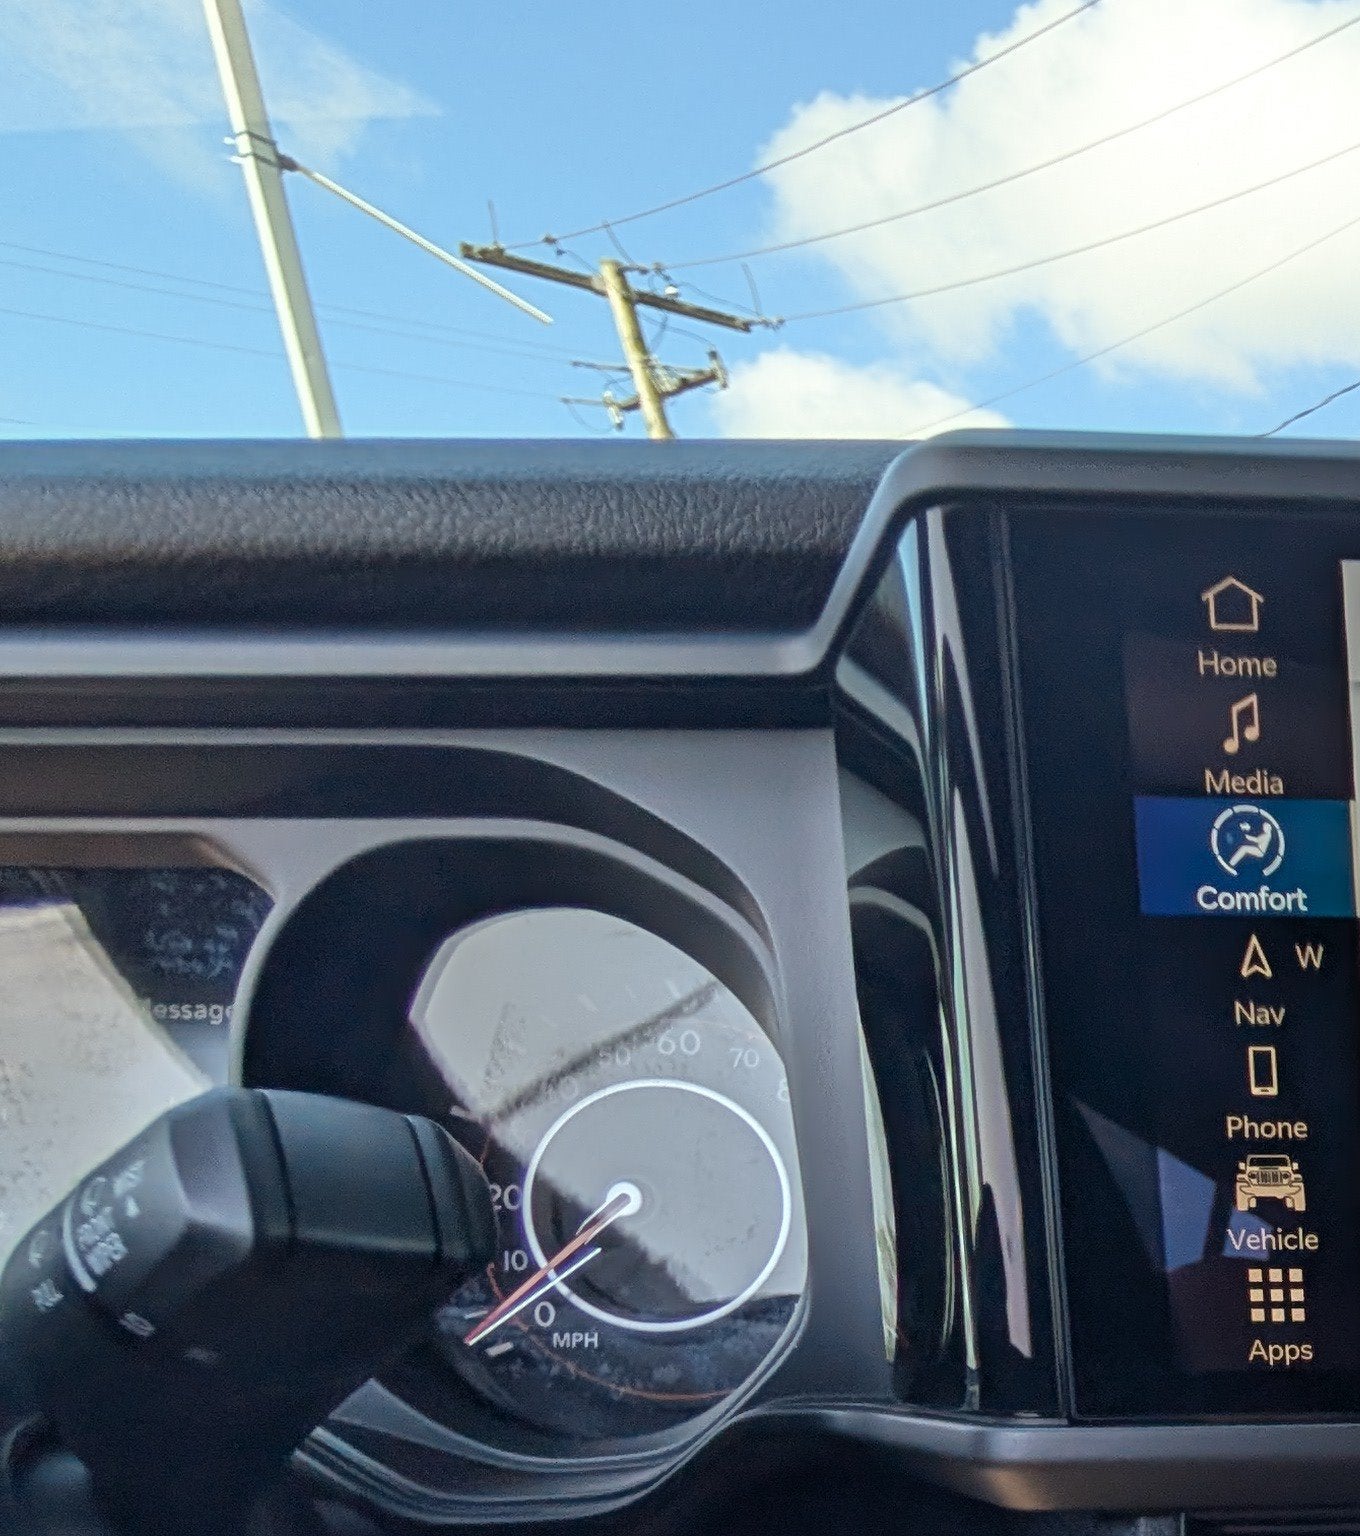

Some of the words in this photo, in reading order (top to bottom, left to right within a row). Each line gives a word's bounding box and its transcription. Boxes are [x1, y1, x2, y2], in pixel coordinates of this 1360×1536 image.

[1198, 650, 1278, 679] Home
[1204, 769, 1285, 796] Media
[1196, 884, 1308, 914] Comfort
[1295, 944, 1324, 970] W
[1234, 1001, 1286, 1027] Nav
[658, 1028, 702, 1057] 60
[729, 1047, 761, 1069] 70
[1225, 1115, 1309, 1141] Phone
[1226, 1227, 1320, 1253] Vehicle
[503, 1249, 529, 1272] 10
[533, 1300, 557, 1328] 0
[552, 1331, 599, 1350] MPH
[1248, 1340, 1314, 1366] Apps
